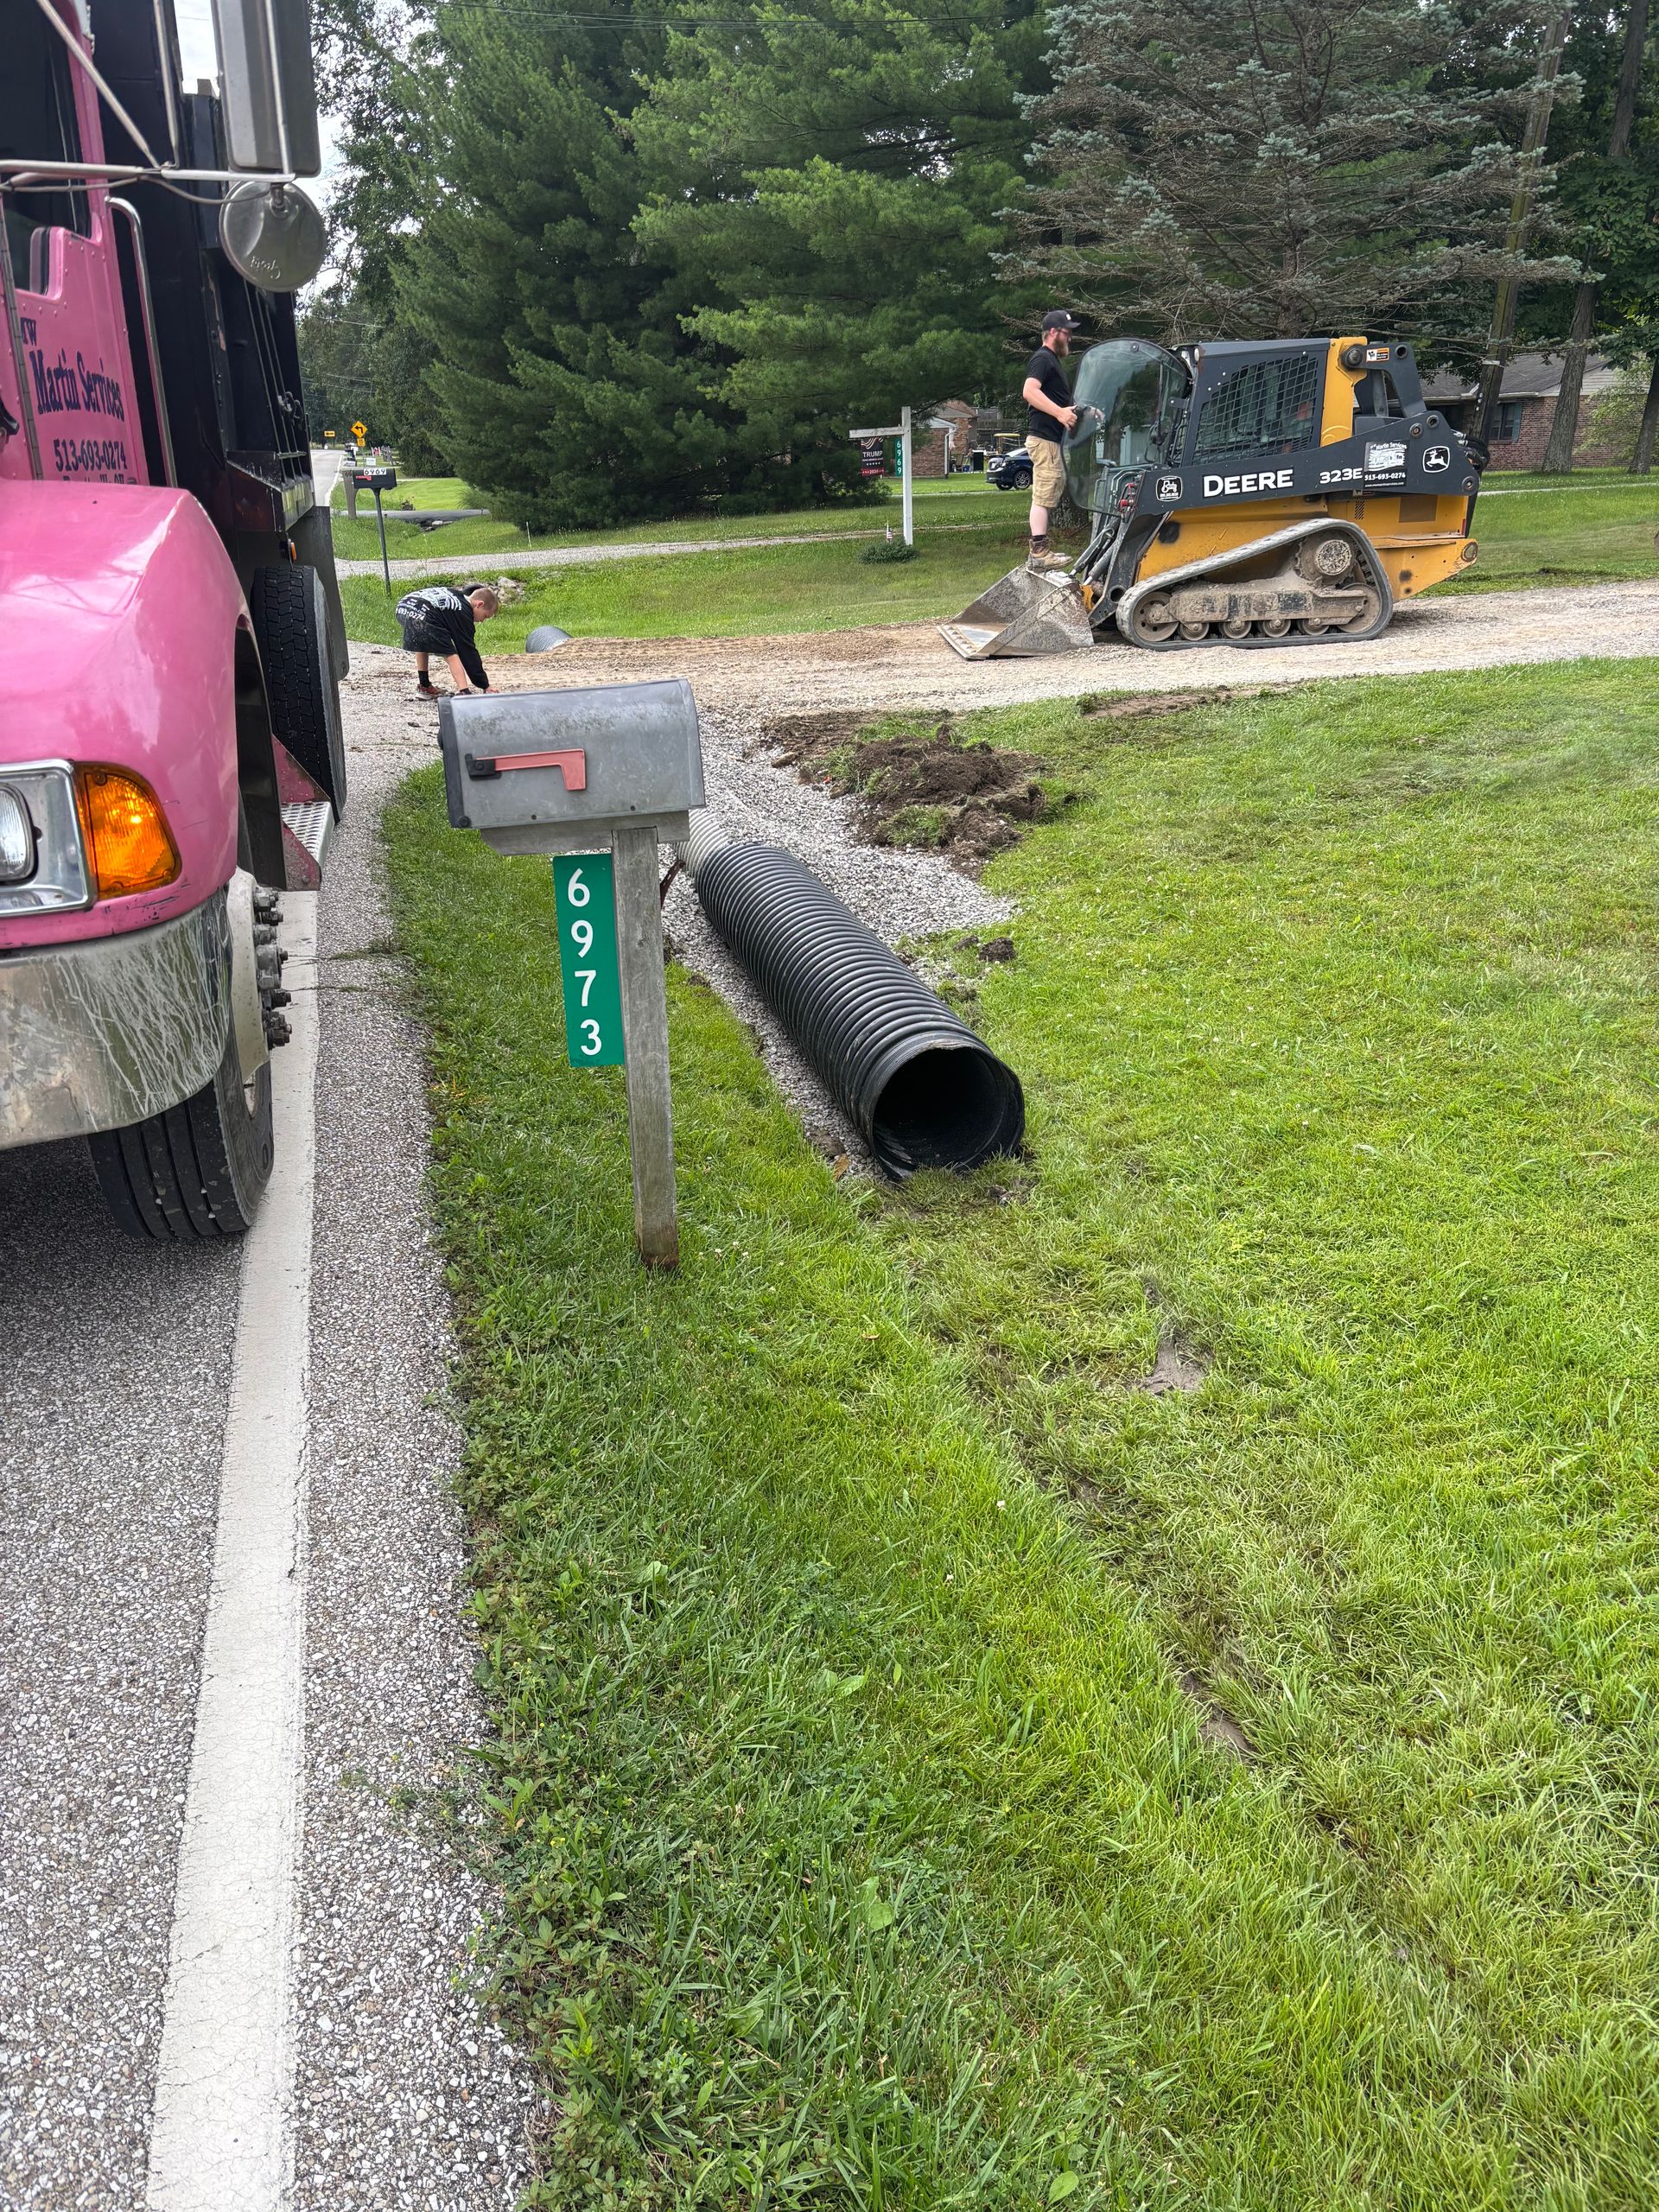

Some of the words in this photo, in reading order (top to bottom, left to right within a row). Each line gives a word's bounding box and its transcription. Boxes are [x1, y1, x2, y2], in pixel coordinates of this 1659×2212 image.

[29, 347, 81, 416] Martin
[76, 351, 124, 423] Services
[53, 438, 128, 473] 513-693-0274
[1203, 468, 1294, 498] DEERE
[1319, 467, 1363, 484] 323E
[1364, 473, 1406, 481] 513-693-0274
[567, 868, 602, 1056] 6973
